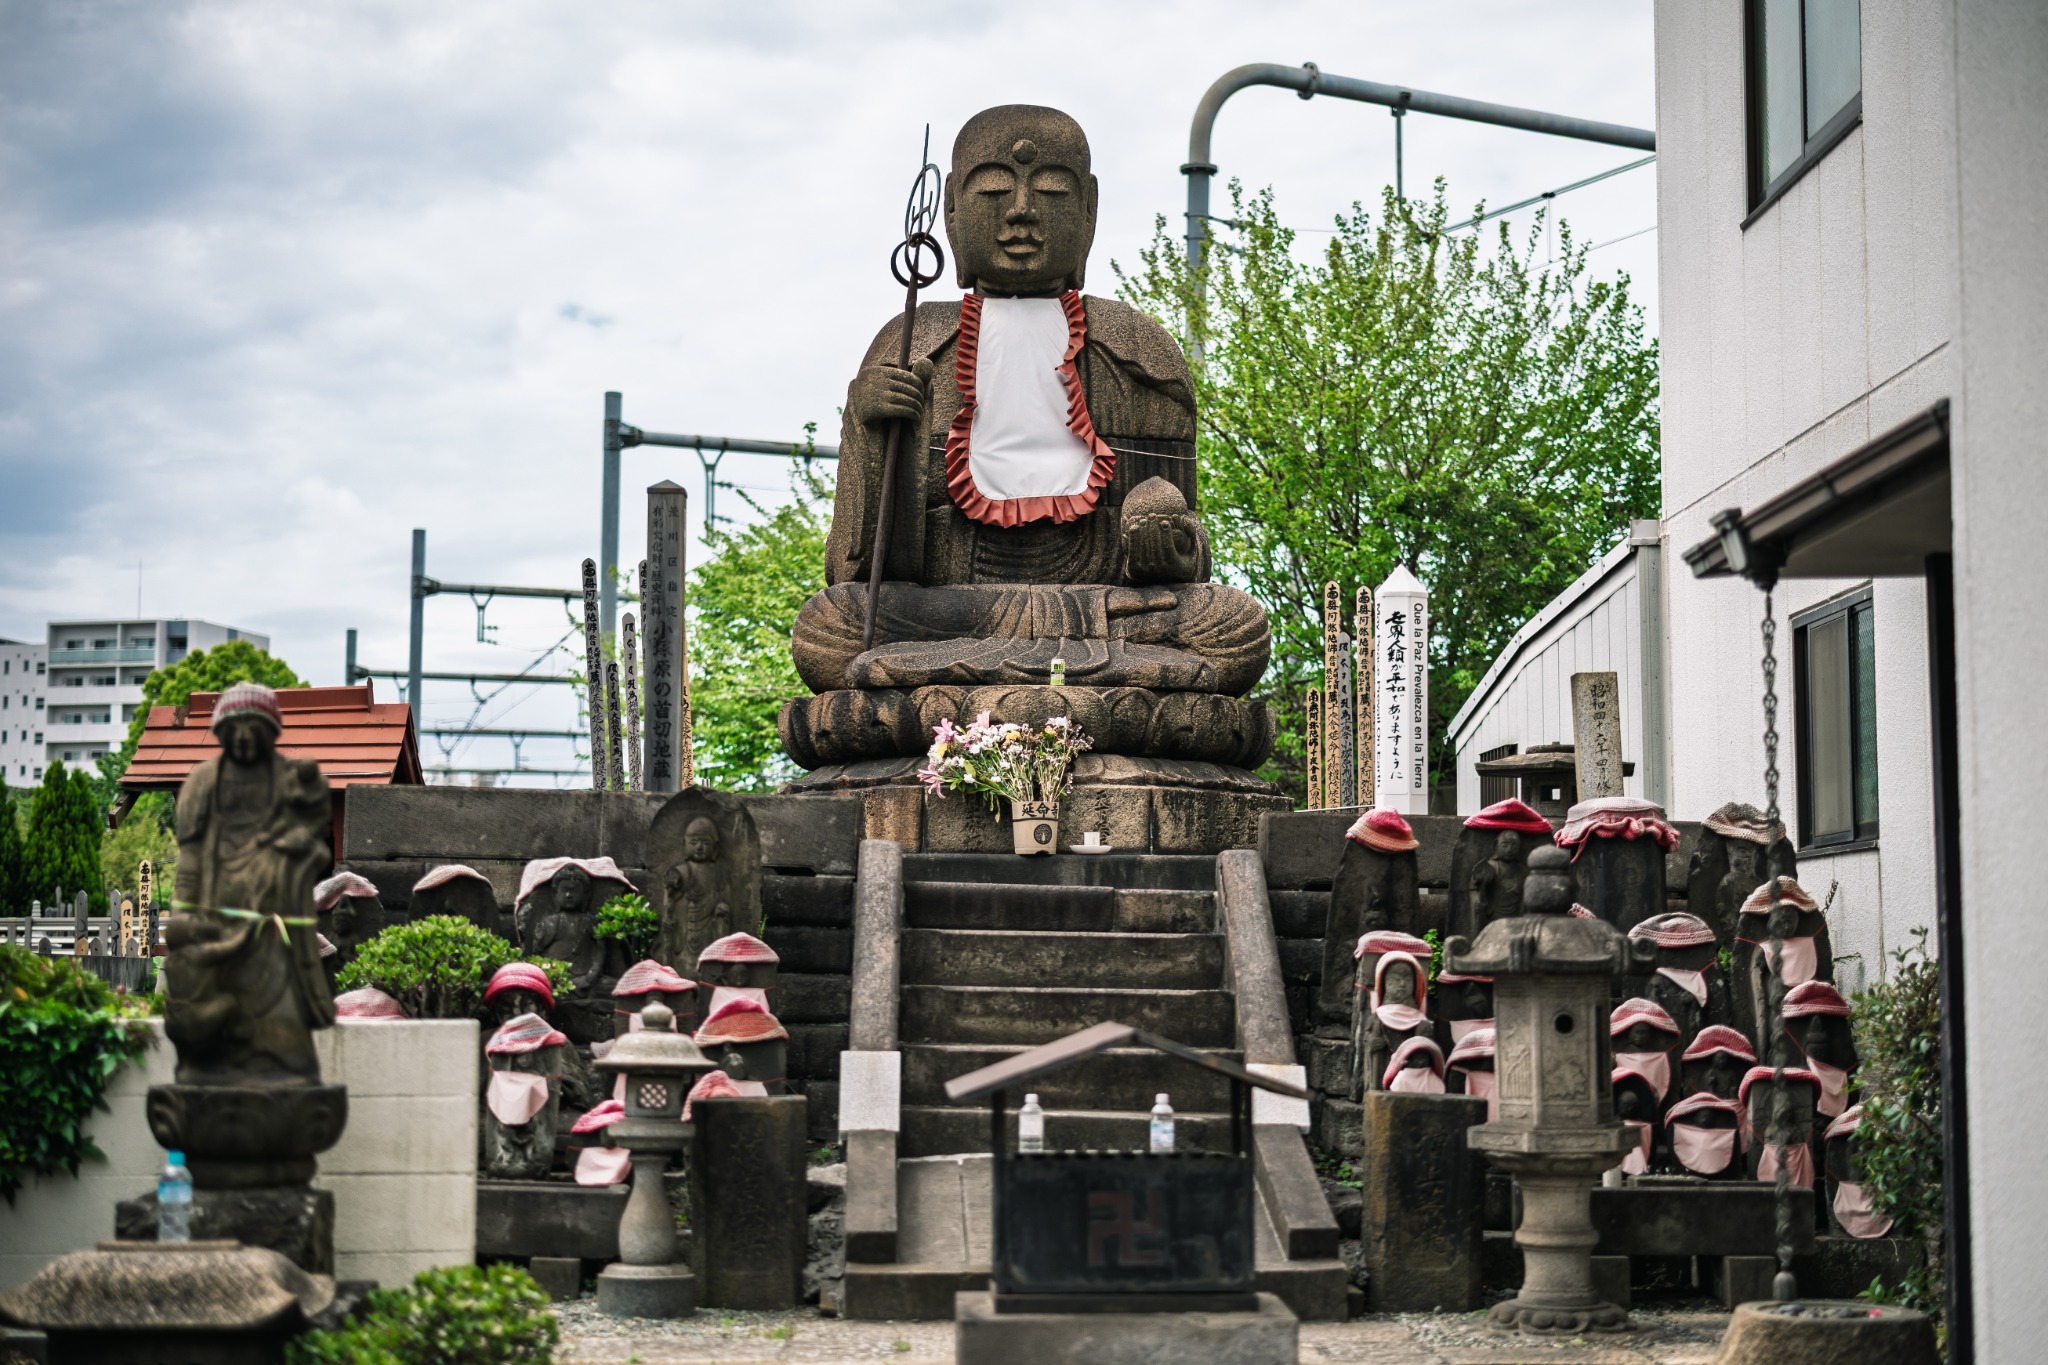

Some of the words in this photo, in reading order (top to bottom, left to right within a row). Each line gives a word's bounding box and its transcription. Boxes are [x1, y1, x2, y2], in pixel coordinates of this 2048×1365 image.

[667, 506, 679, 617] 荒川区指定
[1413, 603, 1423, 625] Que
[1414, 628, 1423, 638] la
[1414, 641, 1423, 661] Paz
[652, 620, 672, 779] 小塚原の首切地蔵
[1385, 610, 1408, 780] 世界人類が平和でありますように
[1414, 664, 1423, 723] Prevalezca
[1414, 726, 1421, 740] en
[1414, 743, 1423, 753] la
[1414, 756, 1423, 788] Tierra
[1021, 802, 1059, 818] 延命寺
